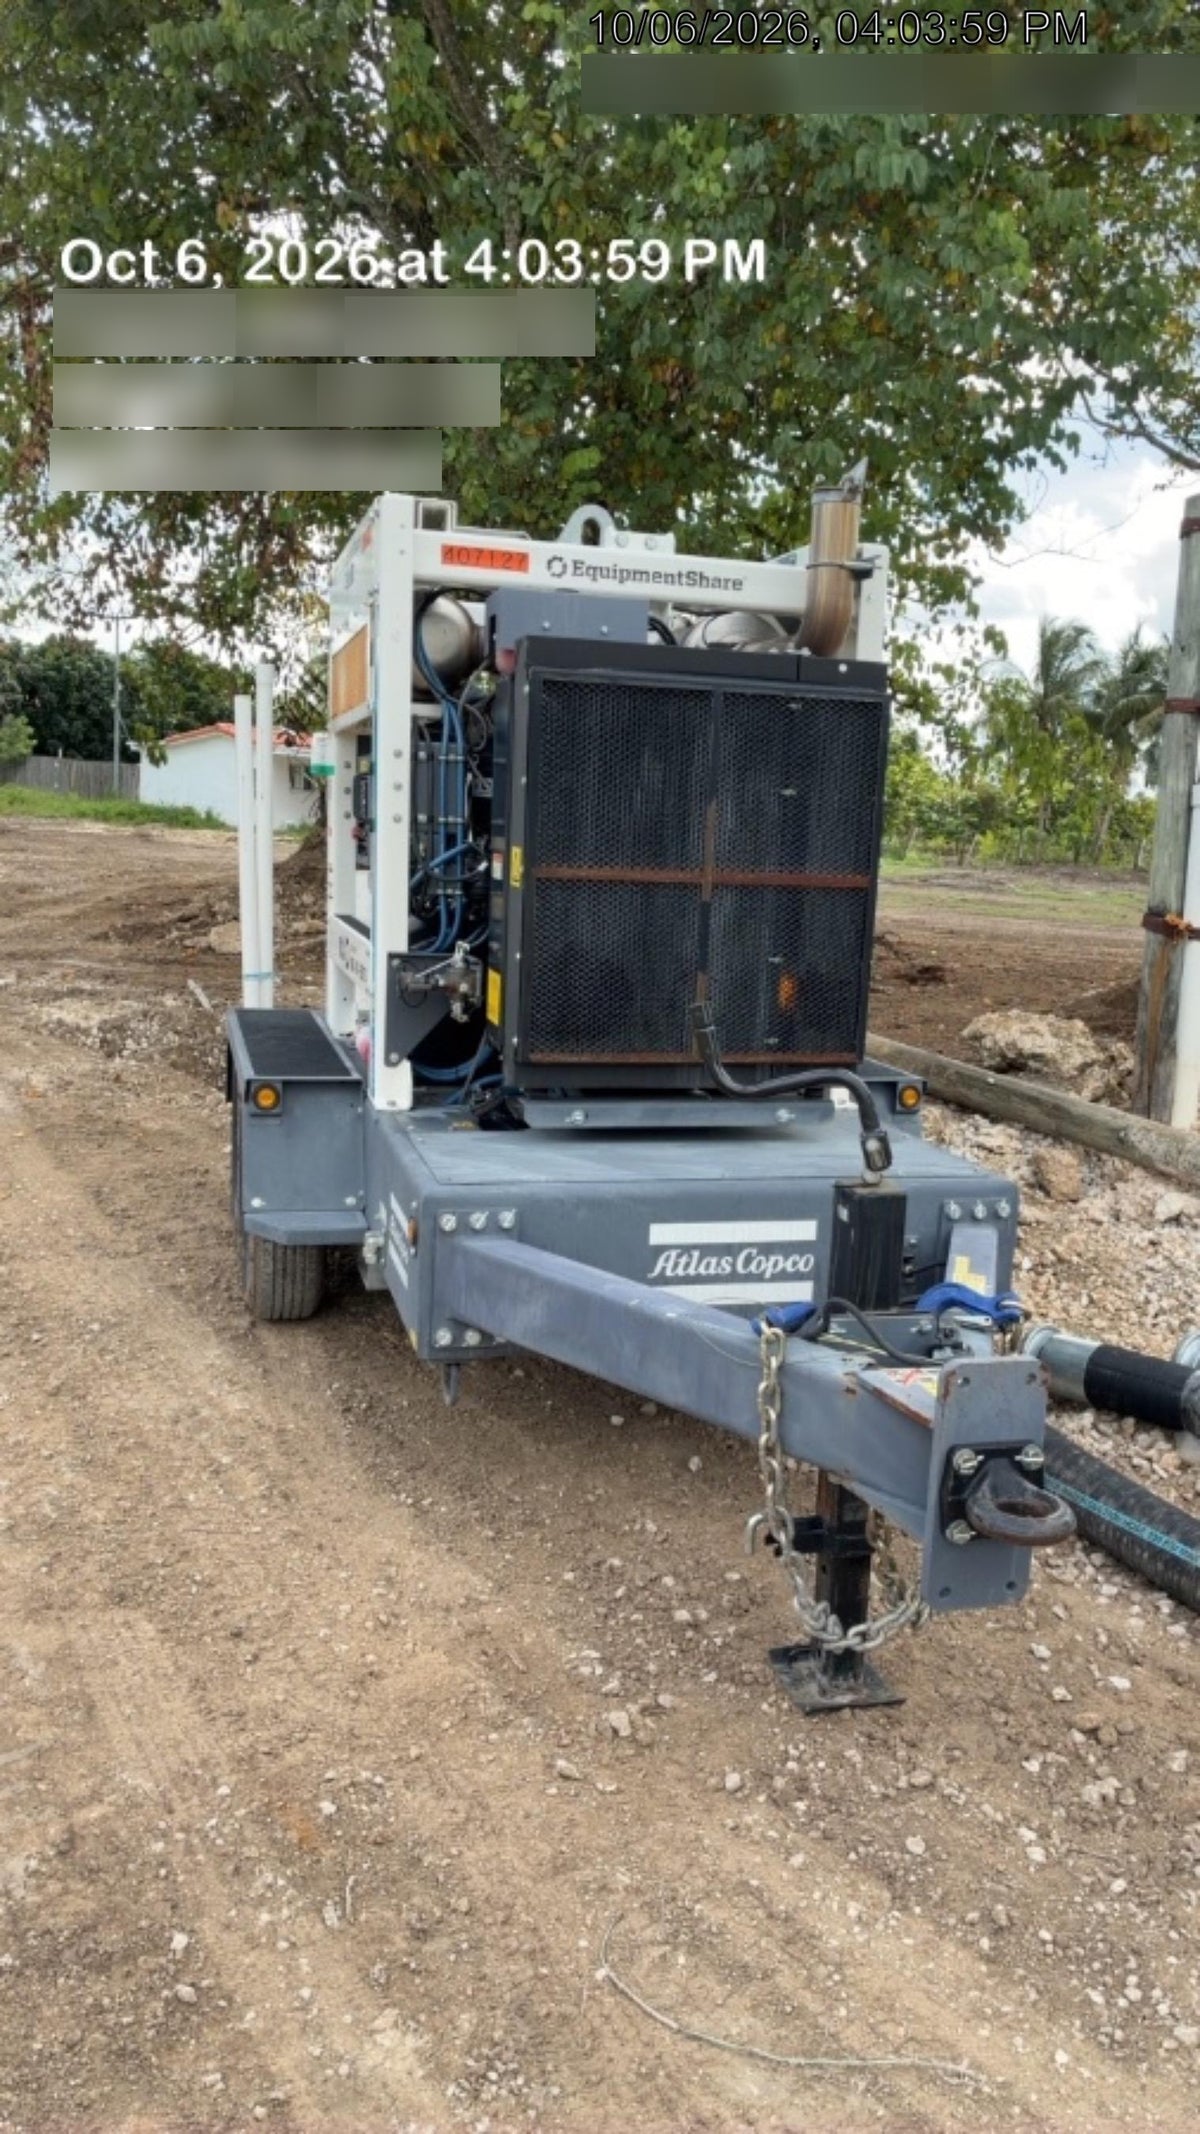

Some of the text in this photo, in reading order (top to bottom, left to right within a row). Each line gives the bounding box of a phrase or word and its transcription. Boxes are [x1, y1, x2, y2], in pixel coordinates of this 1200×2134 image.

[570, 558, 745, 592] EquipmentShare
[647, 1246, 815, 1280] Atlas Copco
